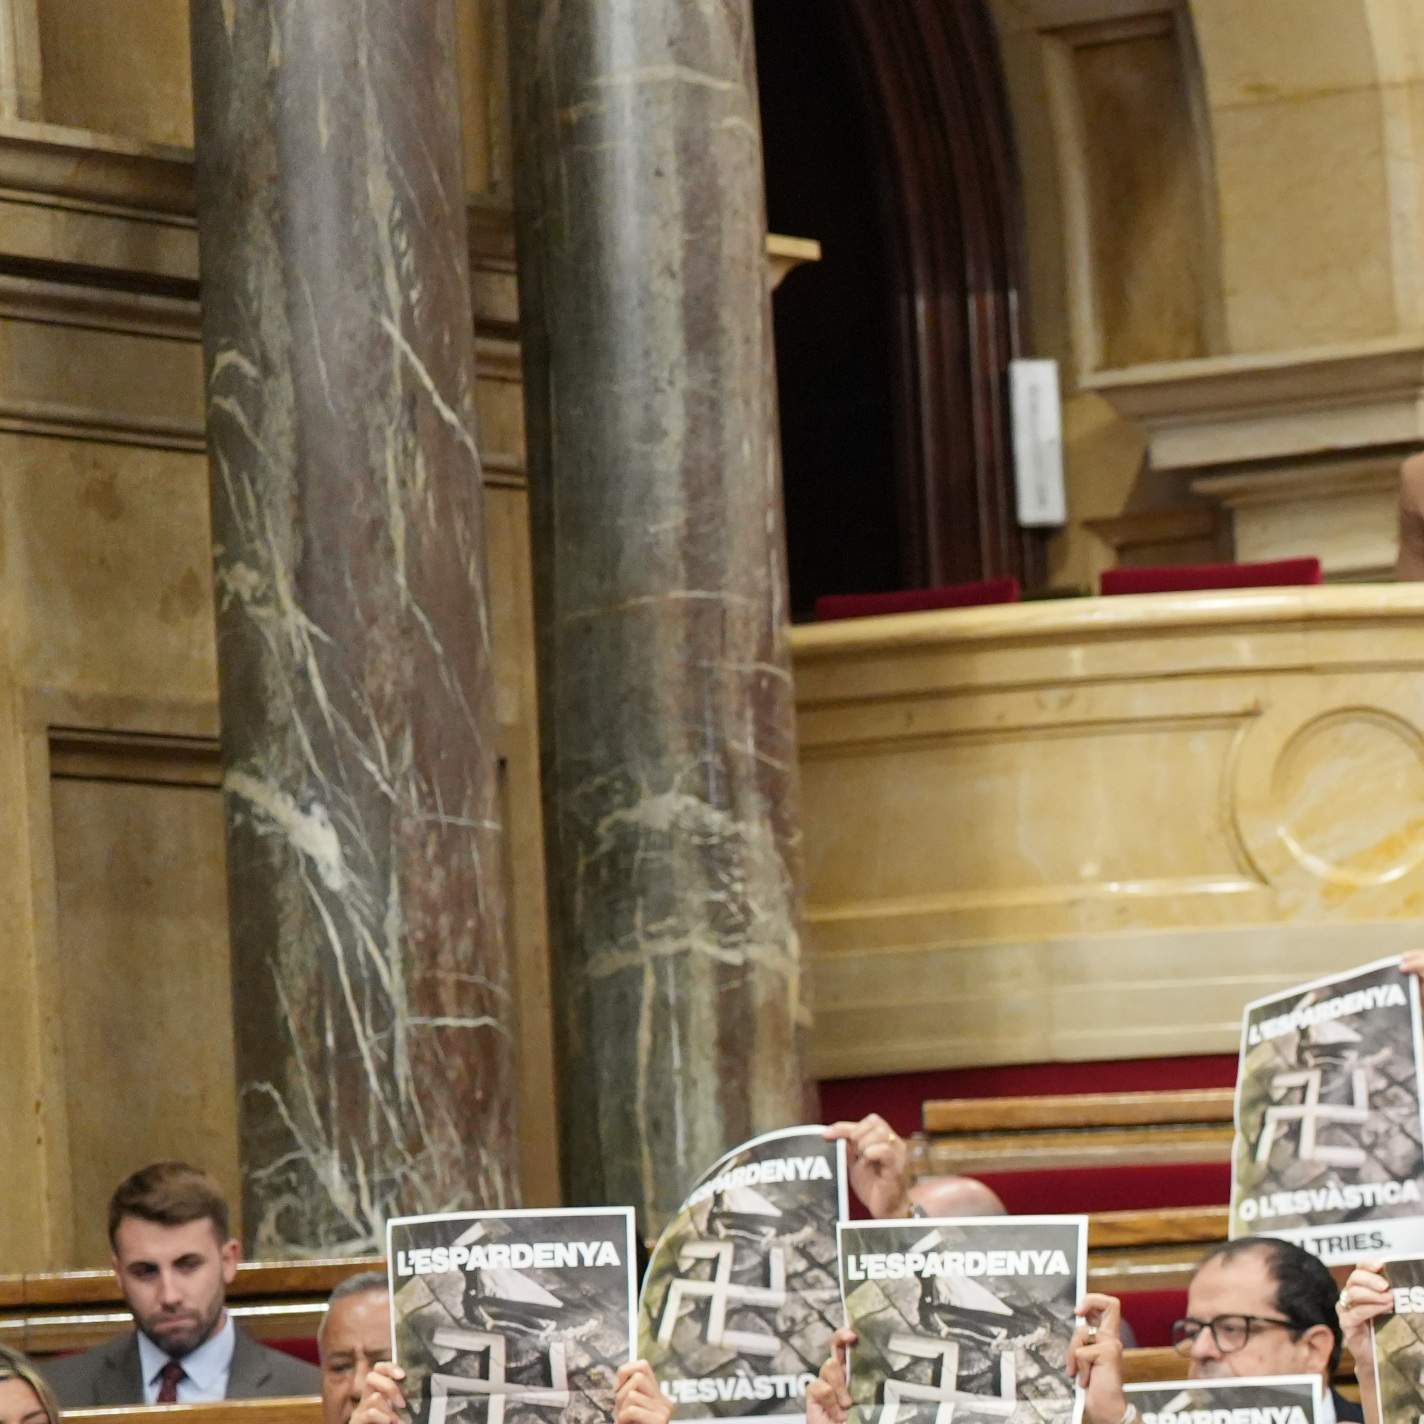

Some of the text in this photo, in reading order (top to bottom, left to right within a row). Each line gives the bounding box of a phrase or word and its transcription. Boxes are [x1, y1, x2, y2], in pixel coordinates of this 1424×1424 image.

[397, 1241, 621, 1276] L'ESPARDENYA
[847, 1250, 1070, 1281] L'ESPARDENYA
[660, 1370, 817, 1403] L'ESVÀSTIC
